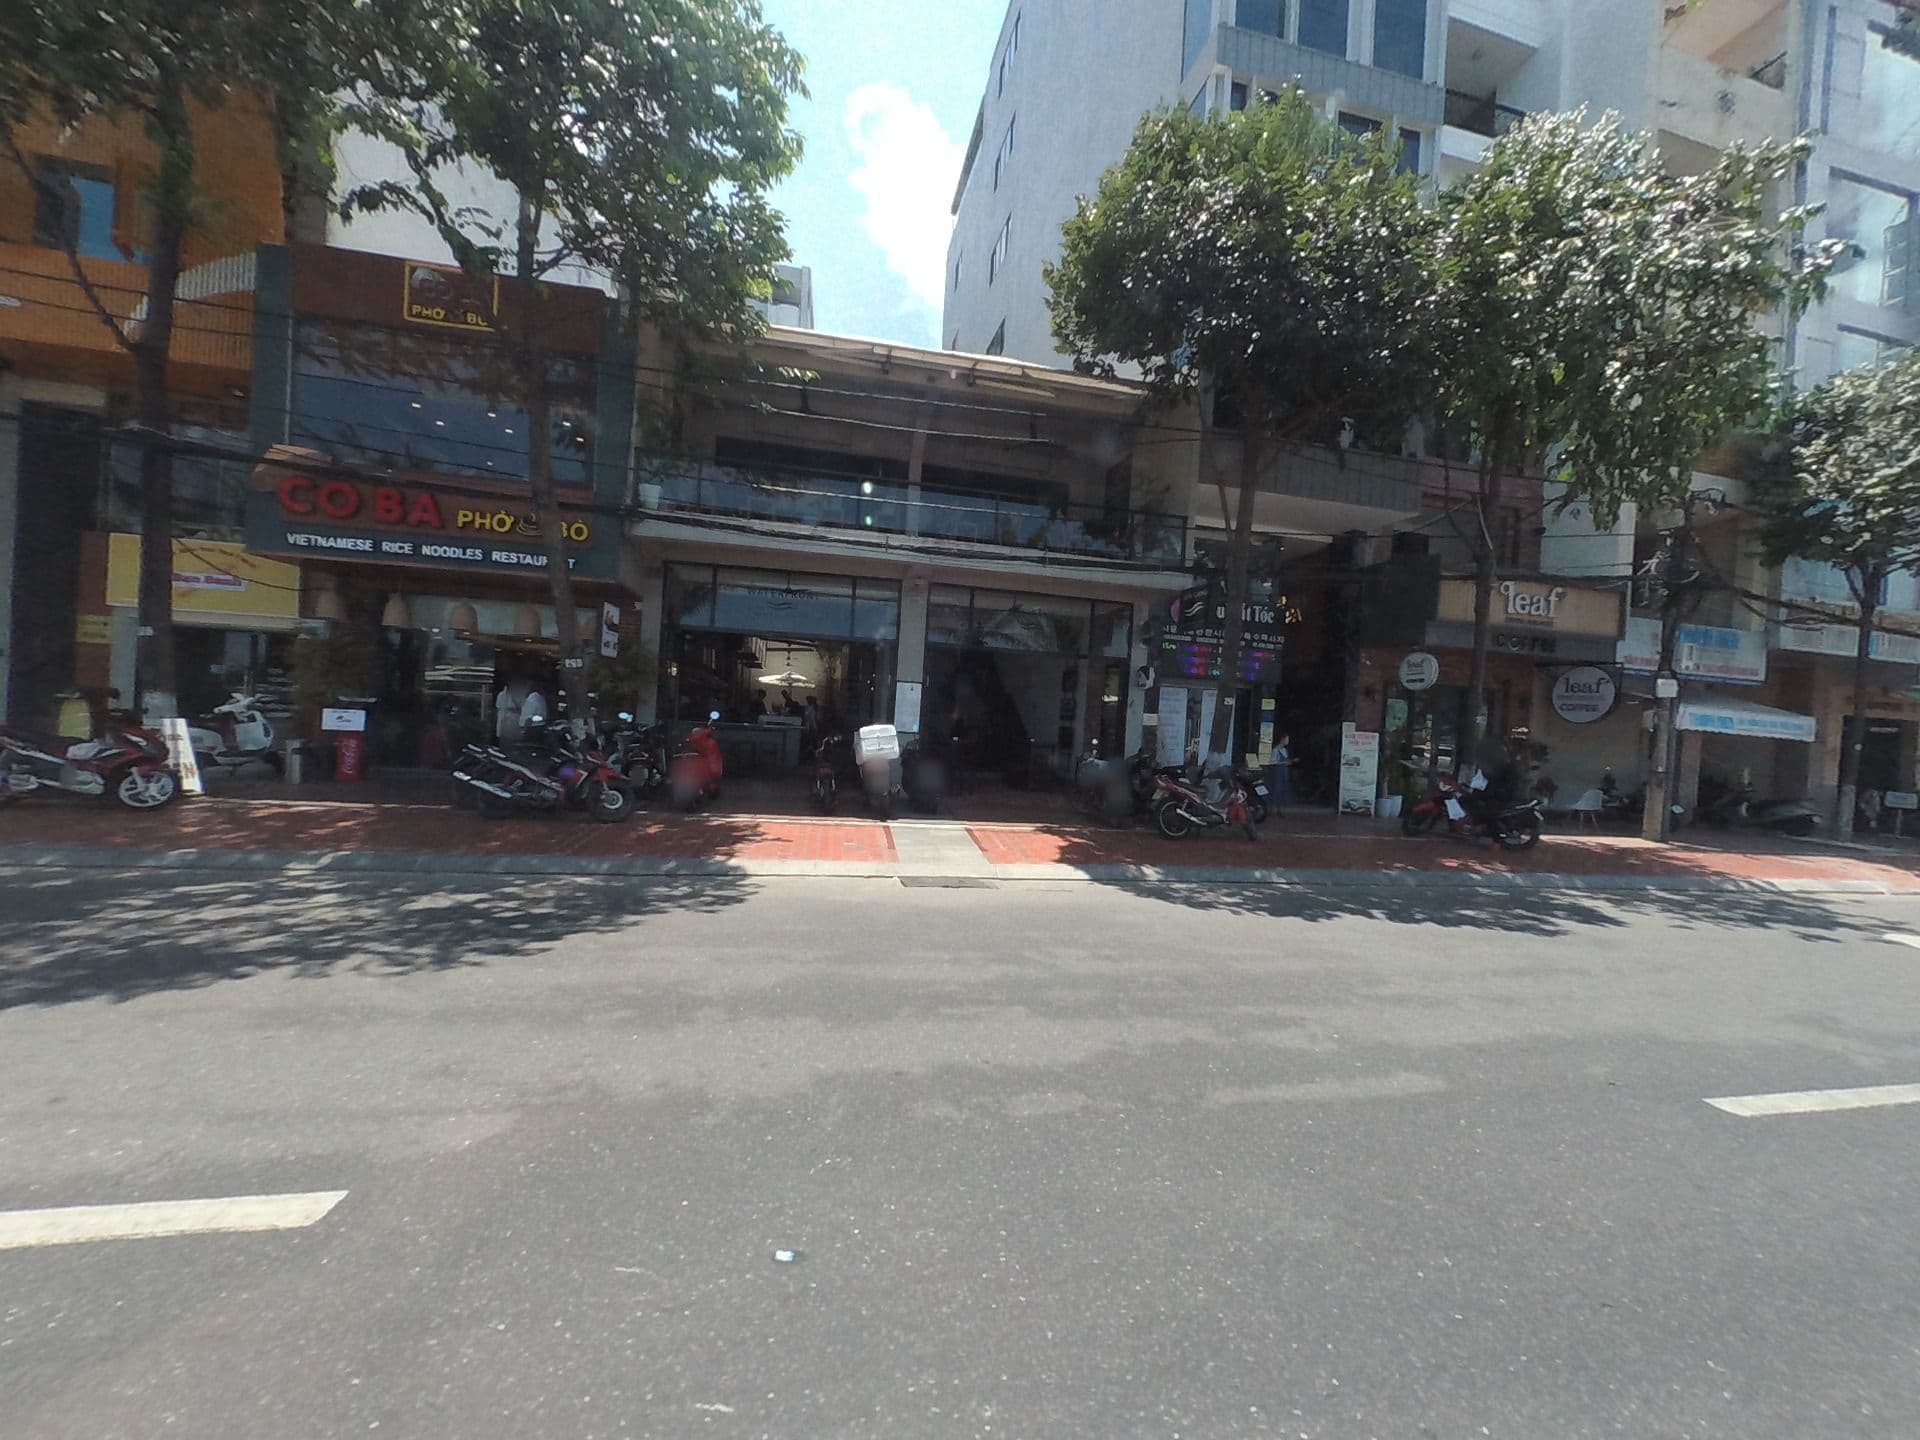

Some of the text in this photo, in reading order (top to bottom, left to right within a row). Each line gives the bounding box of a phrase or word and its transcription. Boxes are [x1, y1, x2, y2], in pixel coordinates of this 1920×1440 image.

[374, 487, 445, 528] BA
[286, 532, 374, 552] VIETNAMESE
[382, 541, 414, 555] RICE
[421, 544, 484, 561] NOODLES
[1500, 580, 1566, 617] leaf
[1564, 677, 1611, 694] leaf
